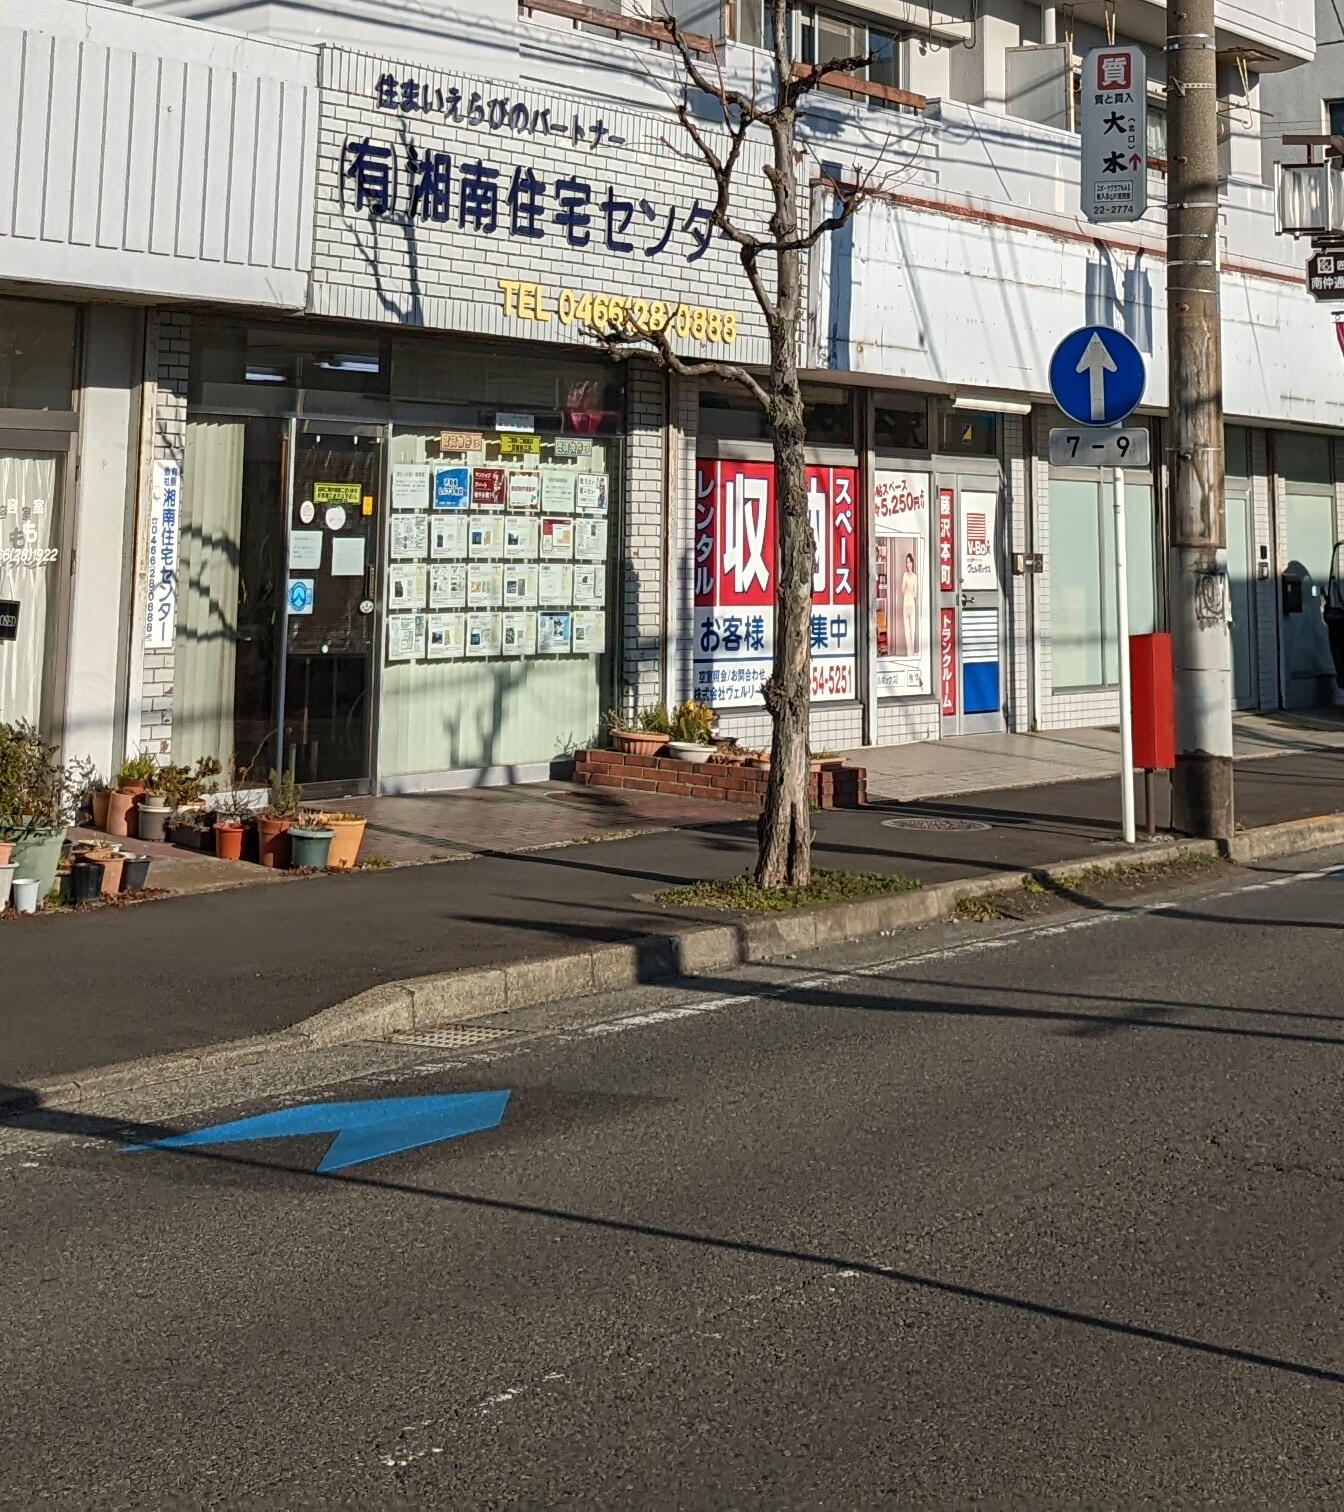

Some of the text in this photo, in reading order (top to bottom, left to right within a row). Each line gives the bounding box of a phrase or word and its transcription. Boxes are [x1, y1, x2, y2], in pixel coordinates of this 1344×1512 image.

[375, 73, 626, 149] 住まいえらびのパートナー
[1094, 92, 1134, 106] 質と買入
[1102, 56, 1128, 86] 質
[1093, 205, 1134, 215] 22-2774
[498, 280, 552, 322] TEL
[159, 488, 177, 642] 湘南住宅センター
[696, 470, 714, 595] レンタル
[835, 478, 852, 594] スペース
[940, 495, 951, 586] 藤沢本町
[941, 614, 955, 709] トランクルーム
